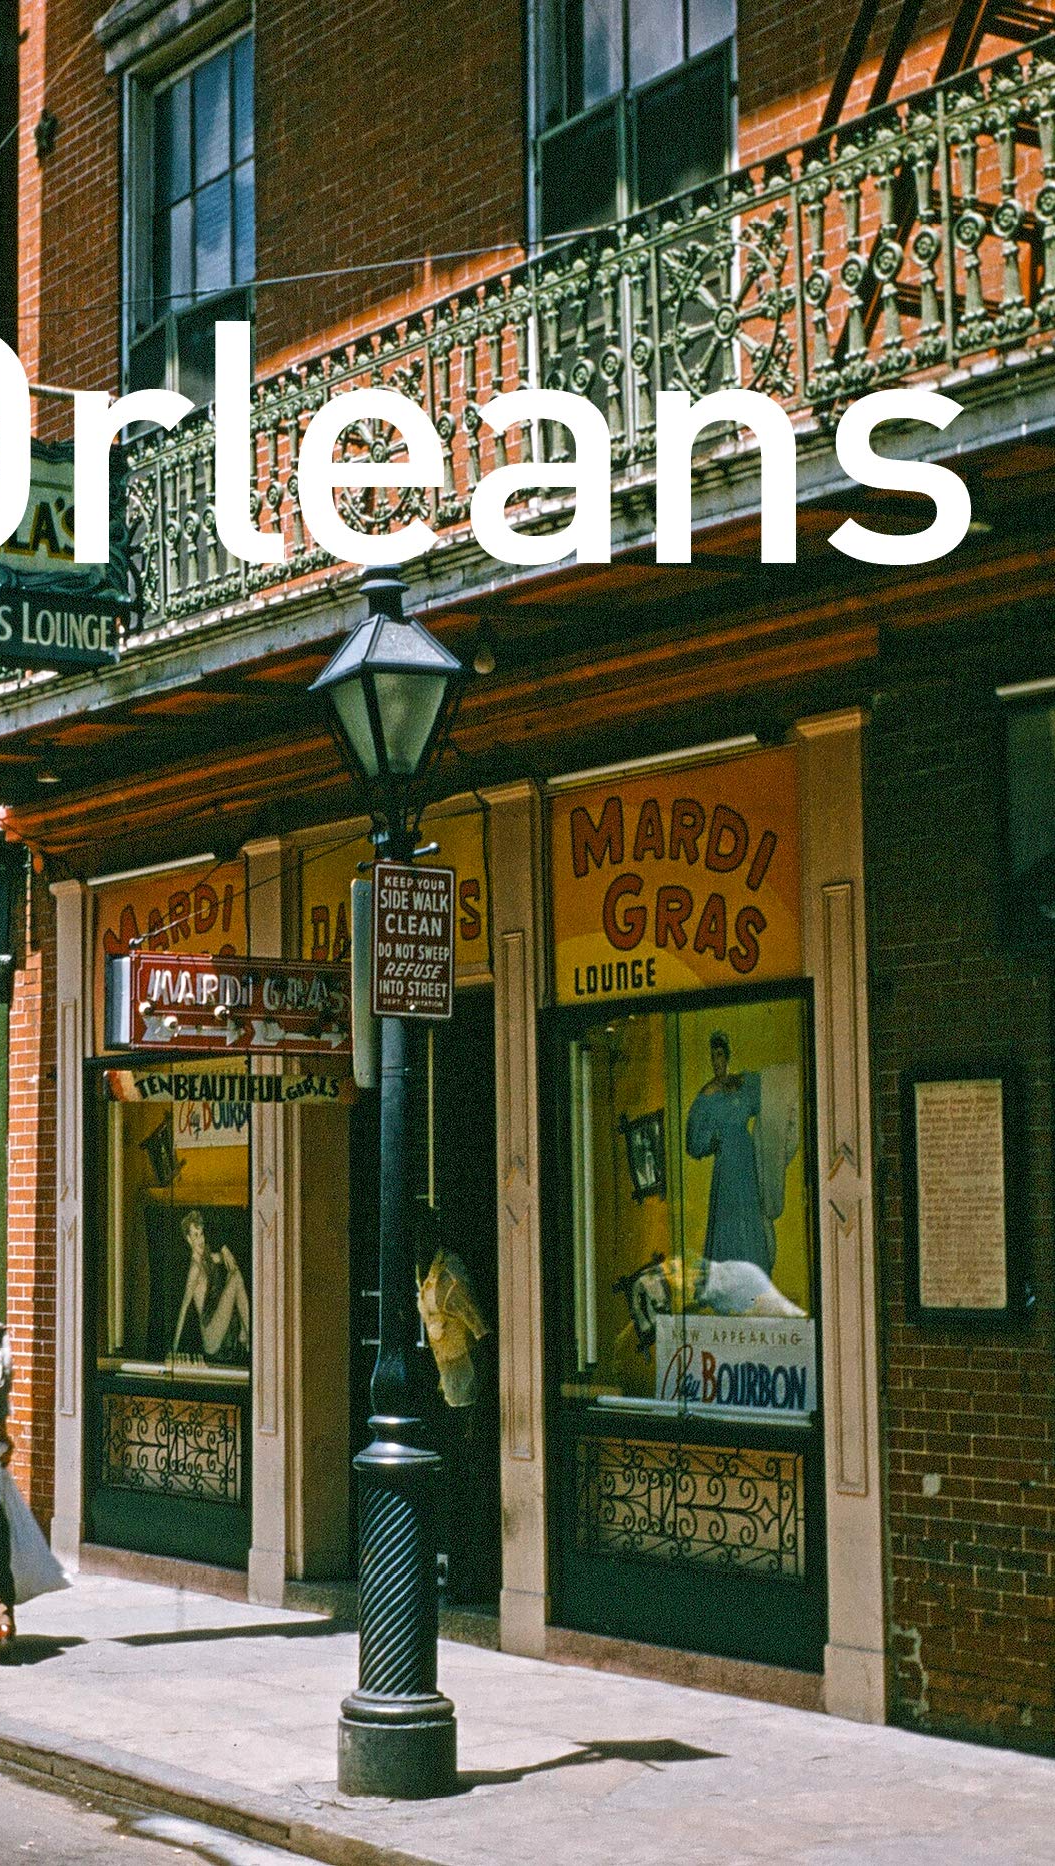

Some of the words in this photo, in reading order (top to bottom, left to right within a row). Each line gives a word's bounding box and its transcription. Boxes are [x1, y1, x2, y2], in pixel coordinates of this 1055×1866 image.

[21, 601, 114, 650] LOUNGE
[570, 795, 779, 892] MARDI
[384, 876, 414, 888] KEEP
[417, 879, 445, 890] YOUR
[380, 889, 410, 910] SIDE
[413, 892, 449, 913] WALK
[385, 914, 442, 937] CLEAN
[602, 871, 768, 975] GRAS
[378, 942, 392, 958] DO
[395, 943, 415, 960] NOT
[418, 944, 450, 961] SWEEP
[383, 962, 443, 979] REFUSE
[574, 957, 656, 996] LOUNGE
[147, 967, 254, 1007] MARDI
[379, 980, 404, 996] INTO
[407, 981, 447, 999] STREET
[135, 1075, 173, 1099] TEN
[174, 1072, 286, 1103] BEAUTIFUL
[285, 1073, 340, 1100] GIRLS
[712, 1330, 802, 1346] APPEARING
[701, 1351, 807, 1410] BOURBON
